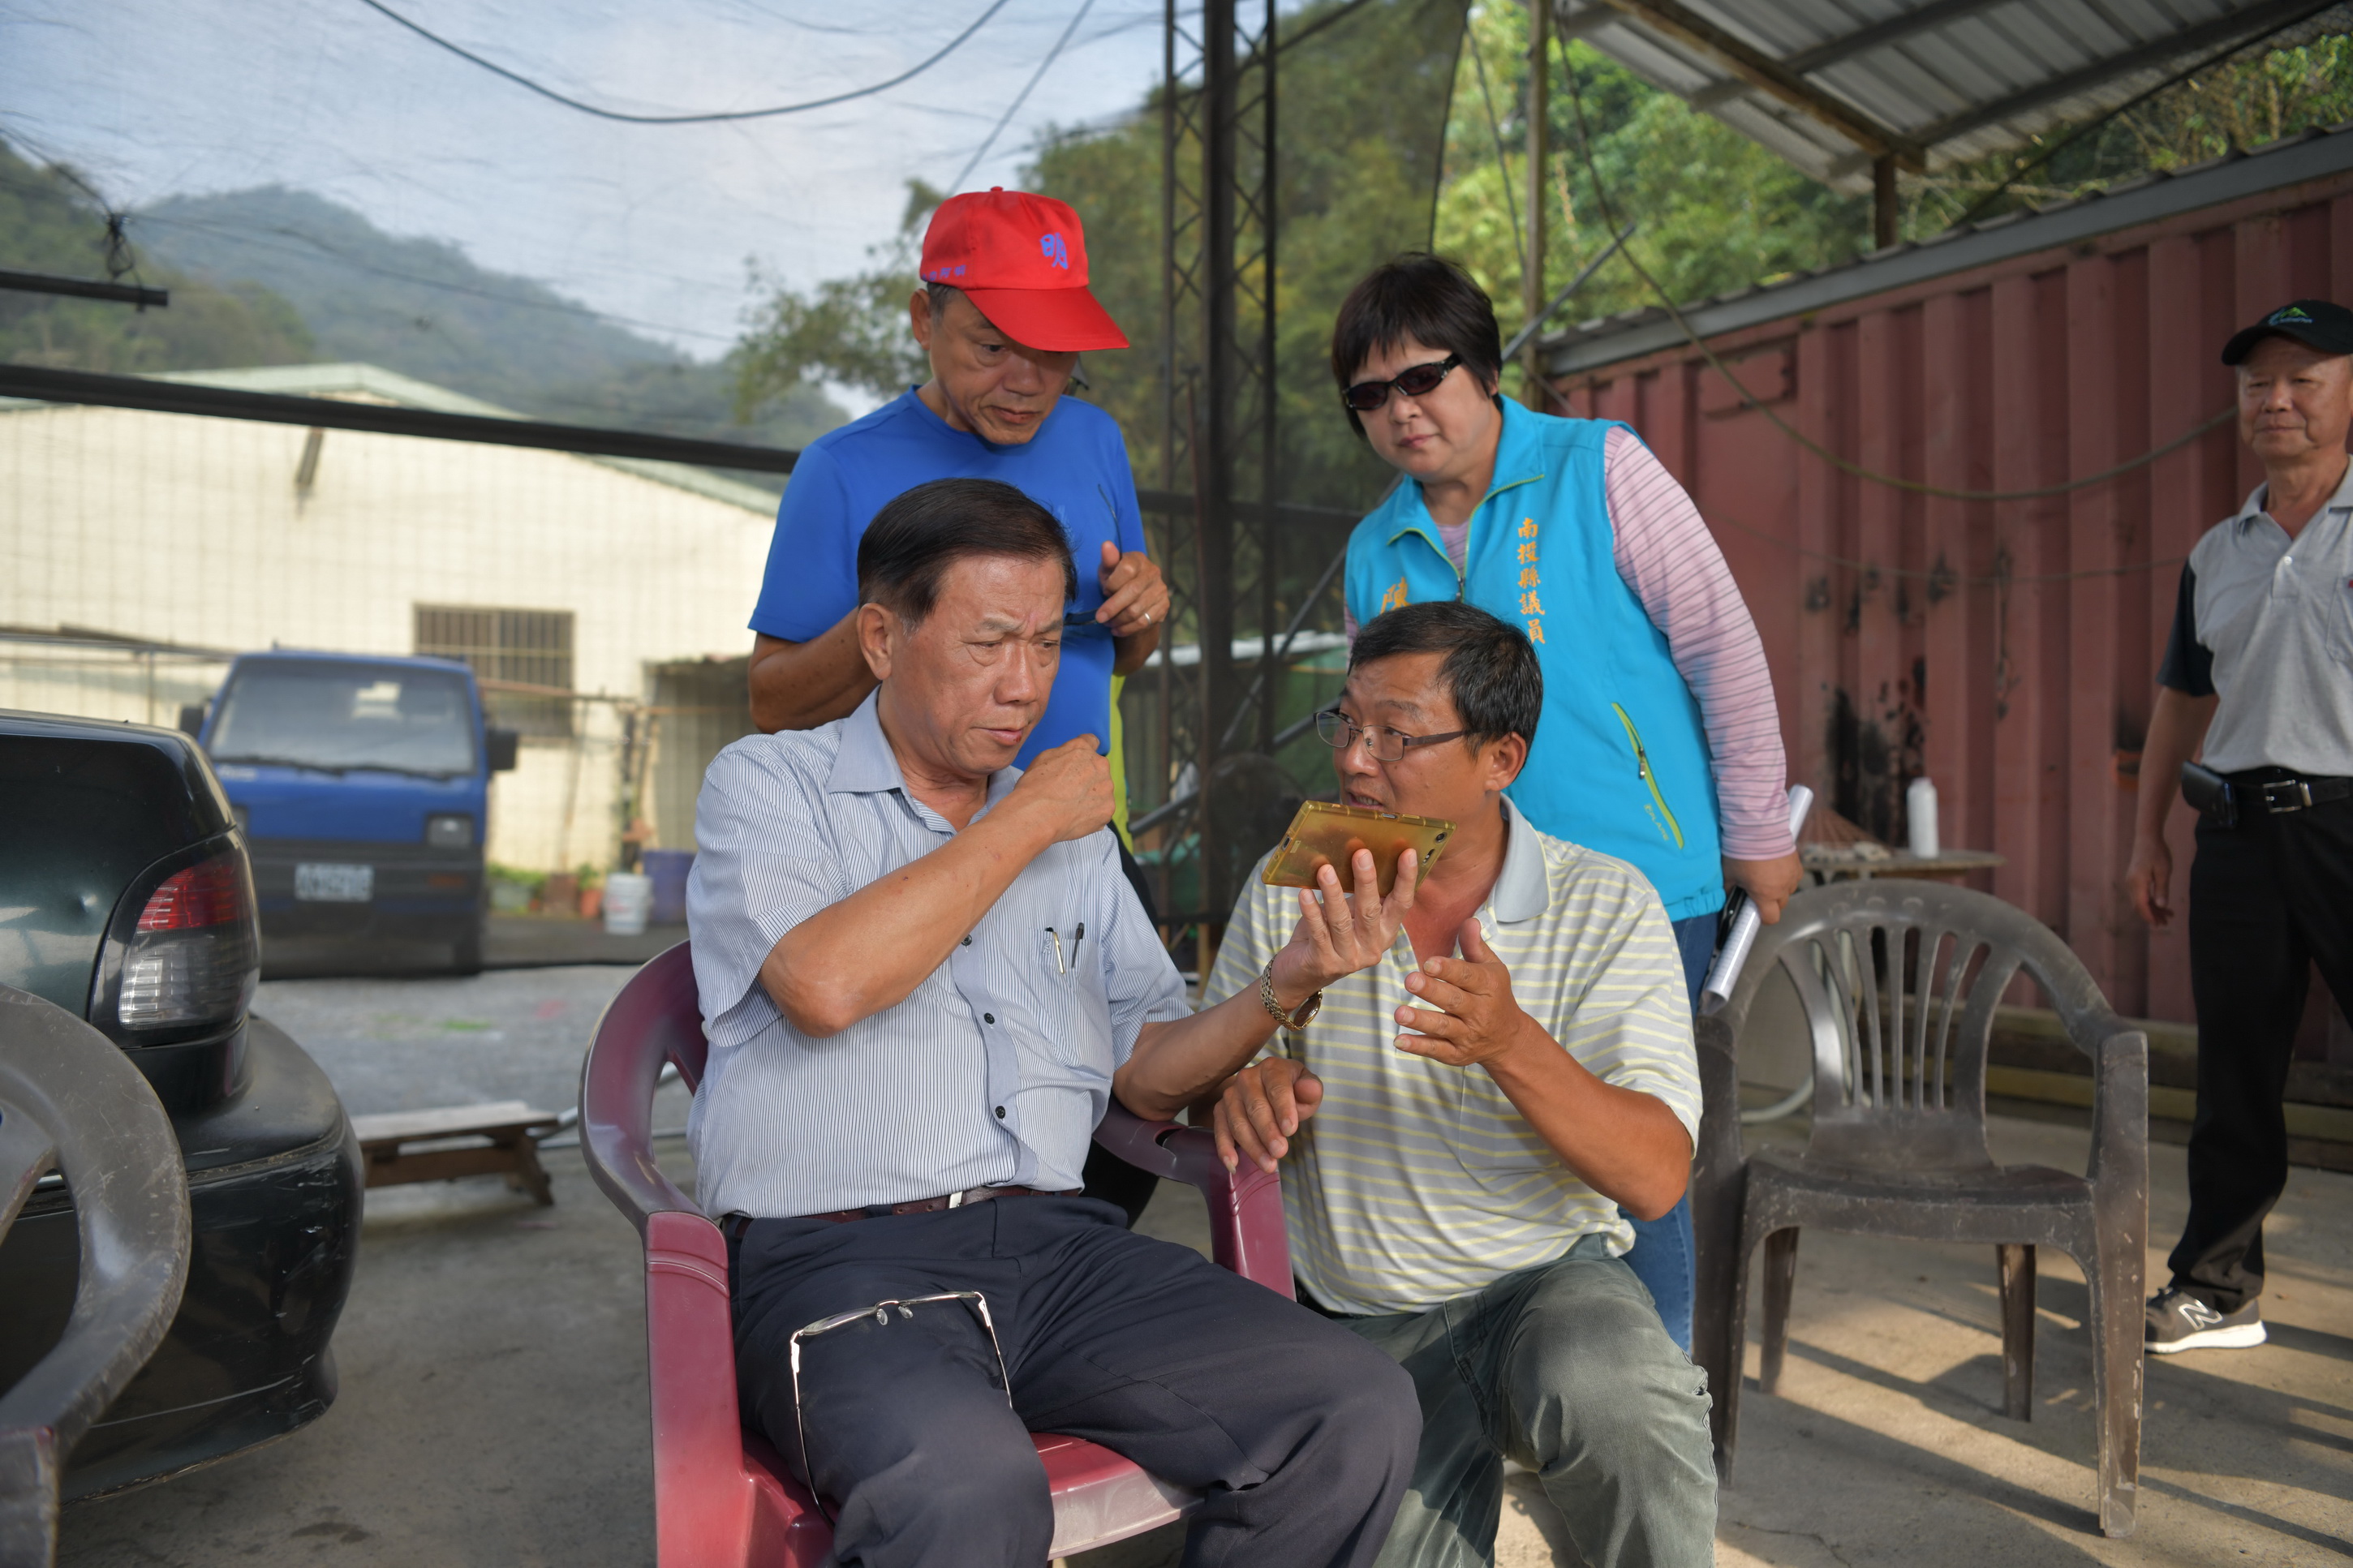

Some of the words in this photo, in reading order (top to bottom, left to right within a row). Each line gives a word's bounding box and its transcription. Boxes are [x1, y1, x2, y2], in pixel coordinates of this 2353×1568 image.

[1040, 232, 1069, 269] 明
[1516, 518, 1546, 644] 南投縣議員
